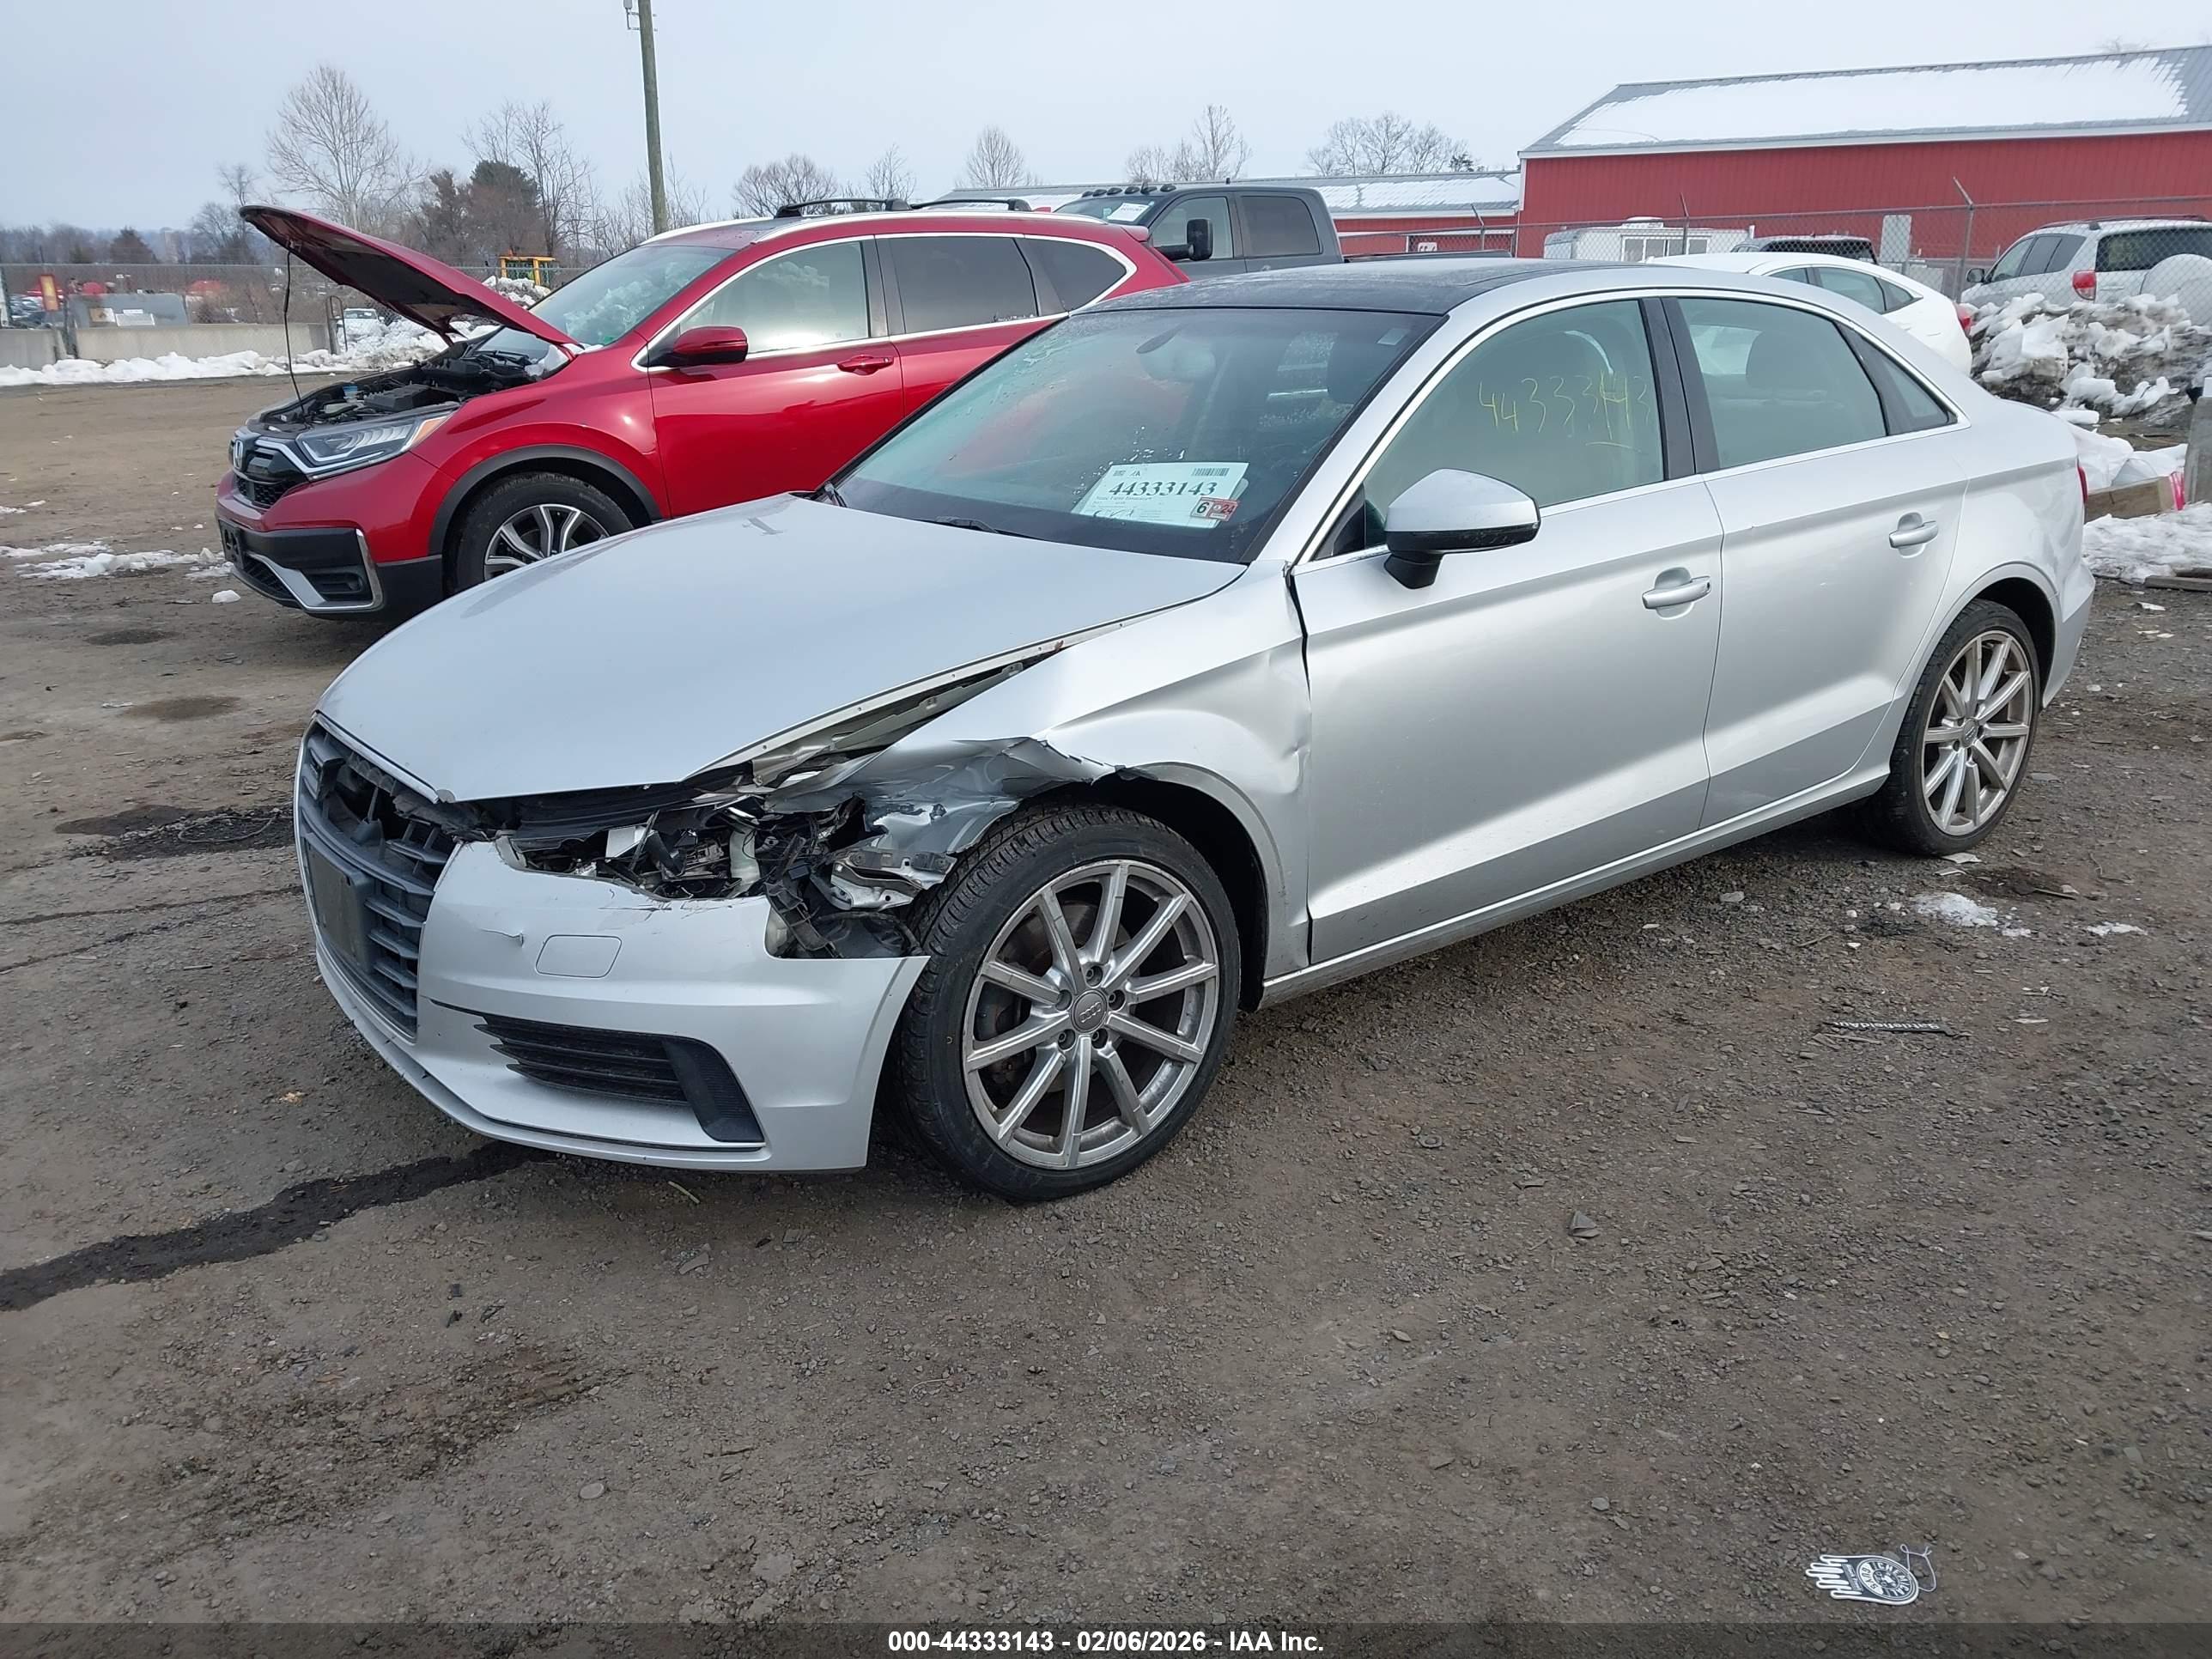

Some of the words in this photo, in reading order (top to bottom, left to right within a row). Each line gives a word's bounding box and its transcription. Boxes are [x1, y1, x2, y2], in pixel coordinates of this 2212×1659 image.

[1109, 481, 1218, 496] 44333143
[1197, 501, 1209, 514] 6
[1220, 504, 1235, 515] 24
[1861, 1567, 1879, 1589] GUYS
[1878, 1562, 1910, 1596] CHEMICAL
